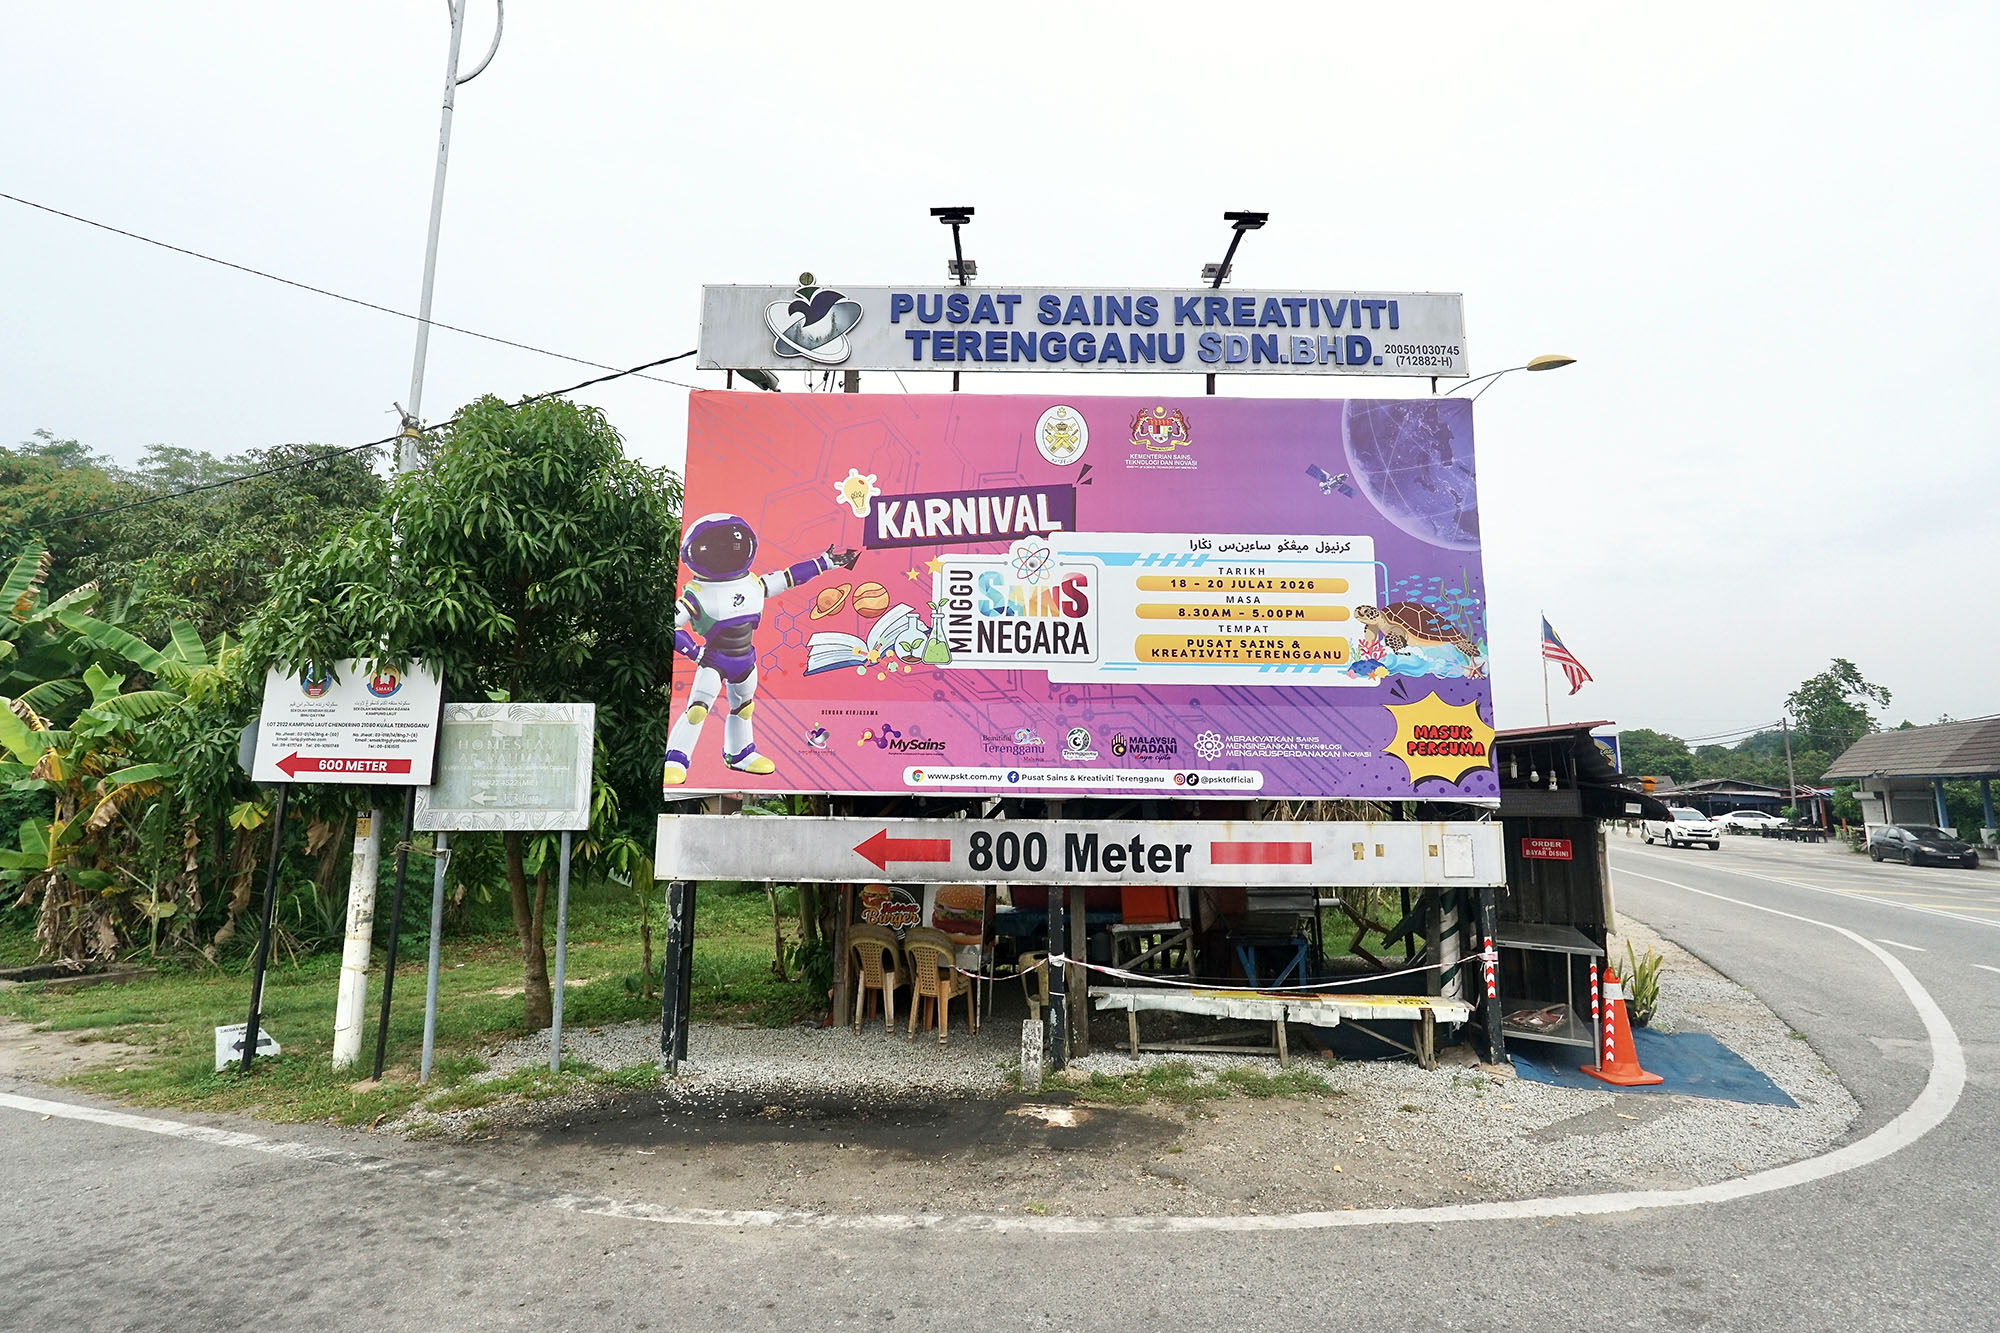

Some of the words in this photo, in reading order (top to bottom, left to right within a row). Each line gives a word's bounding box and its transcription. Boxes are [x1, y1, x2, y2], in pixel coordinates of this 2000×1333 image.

[890, 293, 1022, 325] PUSAT
[1037, 293, 1159, 327] SAINS
[1174, 296, 1400, 330] KREATIVITI
[905, 329, 1186, 364] TERENGGANU
[1197, 332, 1383, 366] SDN.BHD.
[1384, 344, 1460, 356] 200501030745
[1396, 355, 1453, 368] (712882-H)
[877, 493, 1063, 540] KARNIVAL
[1218, 567, 1266, 576] TARIKH
[1170, 579, 1187, 588] 18
[1207, 580, 1224, 589] 20
[1231, 580, 1273, 589] JULAI
[1280, 580, 1315, 590] 2026
[977, 571, 1089, 618] SAINS
[1226, 595, 1261, 604] MASA
[949, 570, 974, 653] MINGGU
[1178, 608, 1232, 617] 8.30AM
[1252, 609, 1305, 618] 5.00PM
[1218, 624, 1269, 634] TEMPAT
[977, 620, 1090, 655] NEGARA
[1187, 639, 1234, 648] PUSAT
[1240, 639, 1284, 649] SAINS
[1292, 640, 1301, 649] &
[1151, 649, 1239, 659] KREATIVITI
[1246, 650, 1342, 660] TERENGGANU
[1413, 725, 1473, 740] MASUK
[458, 739, 554, 751] HOMESTAY
[889, 738, 946, 752] MySains
[1129, 736, 1177, 745] MALAYSIA
[1225, 735, 1294, 743] MERAKYATKAN
[982, 742, 1045, 756] Terengganu
[1129, 744, 1178, 754] MADANI
[1225, 750, 1340, 758] MENGARUSPERDANAKAN
[1407, 741, 1486, 757] PERCUMA
[318, 759, 343, 771] 600
[345, 760, 388, 772] METER
[927, 773, 1003, 782] www.pskt.com.my
[1077, 774, 1114, 782] Kreativiti
[1116, 775, 1165, 783] Terengganu
[1200, 776, 1254, 785] @psktofficial
[968, 830, 1048, 873] 800
[1064, 832, 1192, 874] Meter
[861, 907, 919, 929] Burger
